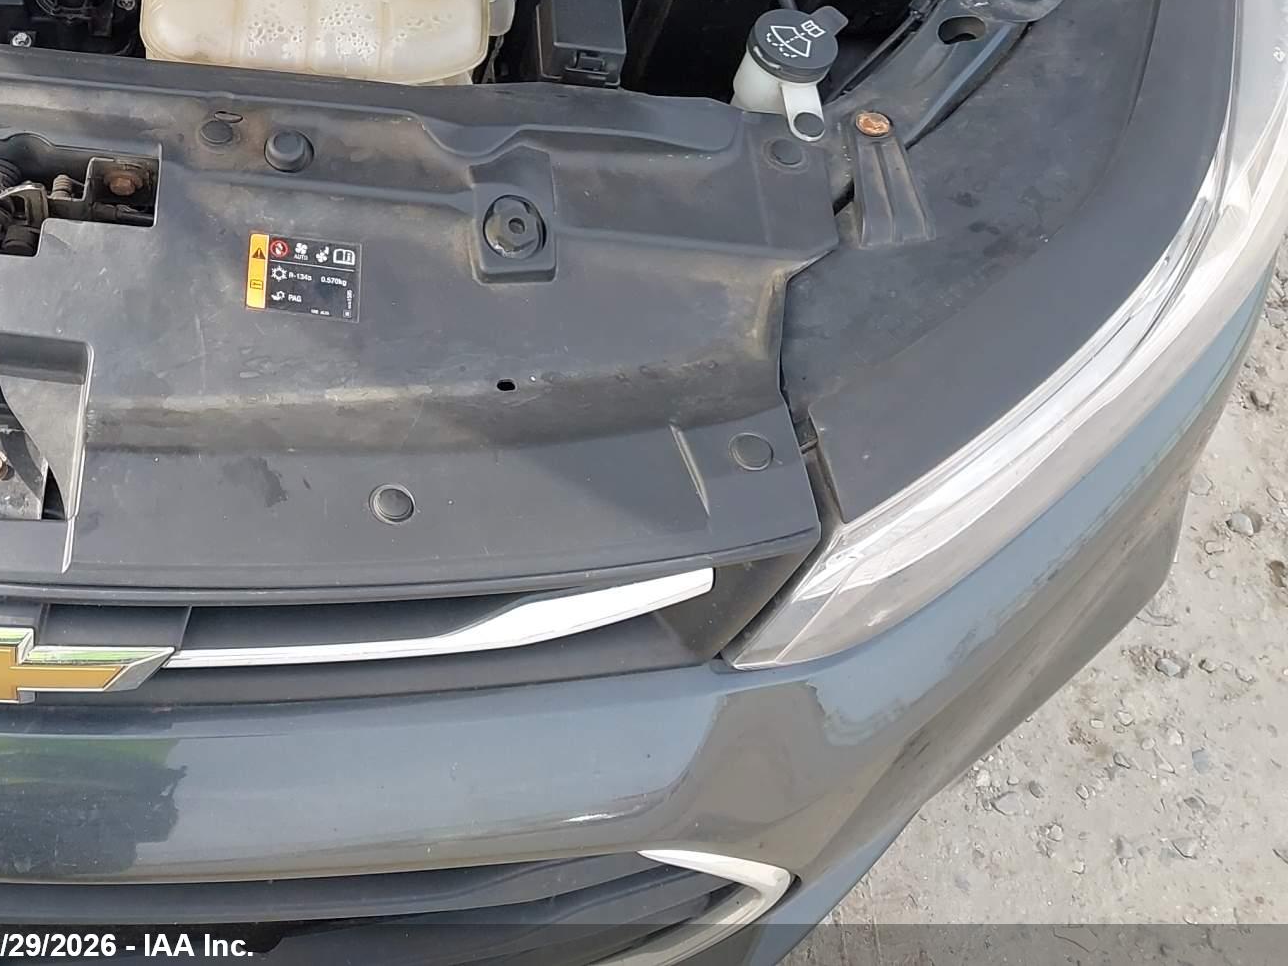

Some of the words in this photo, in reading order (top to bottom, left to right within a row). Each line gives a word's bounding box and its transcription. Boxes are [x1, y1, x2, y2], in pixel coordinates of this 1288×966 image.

[288, 272, 312, 282] R-134a
[320, 276, 347, 287] 0.570kg
[288, 294, 302, 303] PAG
